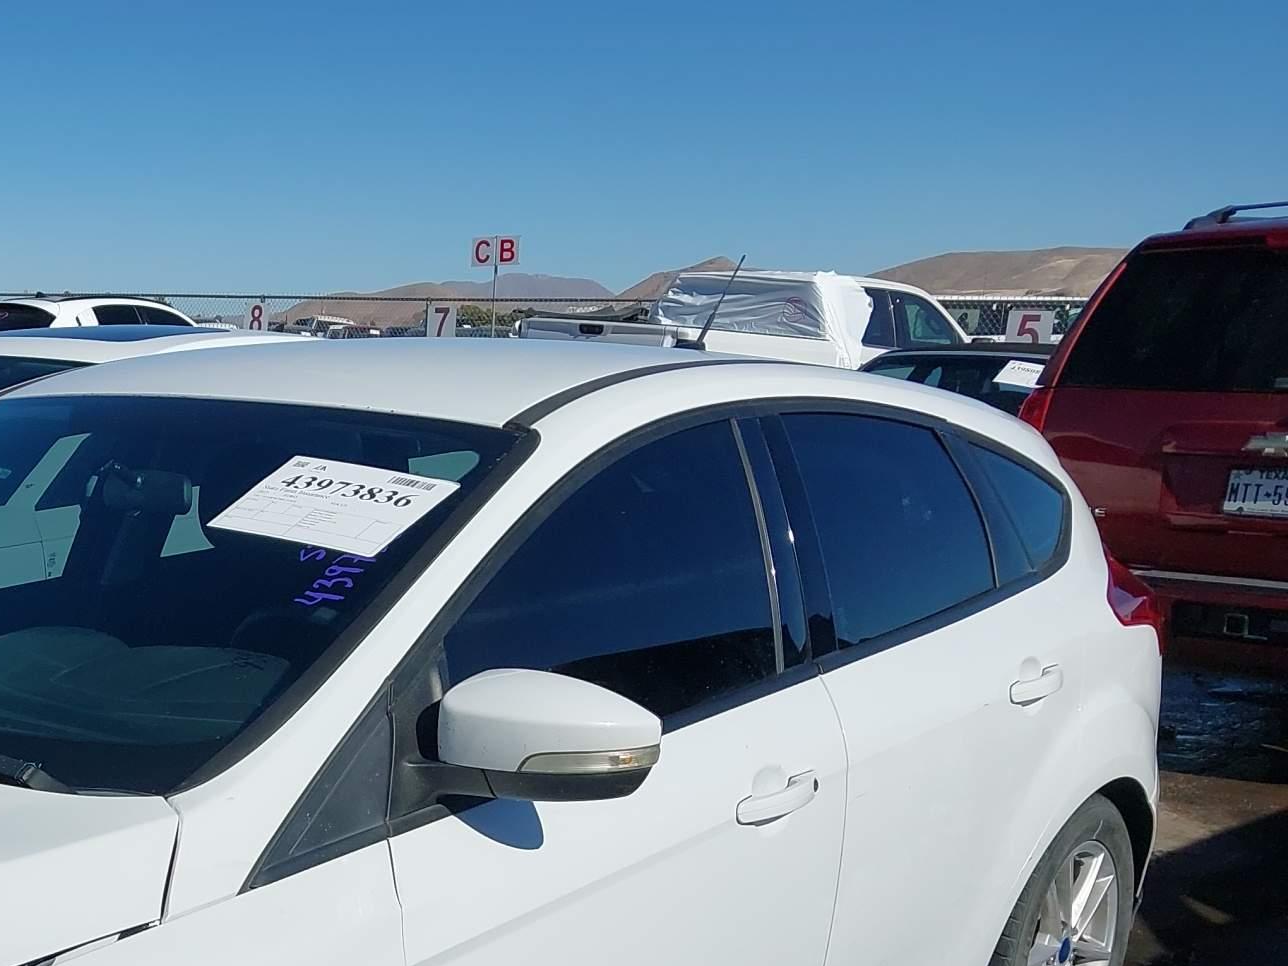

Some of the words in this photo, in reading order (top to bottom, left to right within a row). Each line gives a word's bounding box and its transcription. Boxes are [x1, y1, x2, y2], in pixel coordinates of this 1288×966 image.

[475, 239, 491, 264] C
[499, 239, 515, 263] B
[251, 304, 262, 330] 8
[434, 307, 450, 337] 7
[1016, 314, 1041, 343] 5
[280, 474, 420, 509] 43973836
[294, 553, 377, 606] 4397
